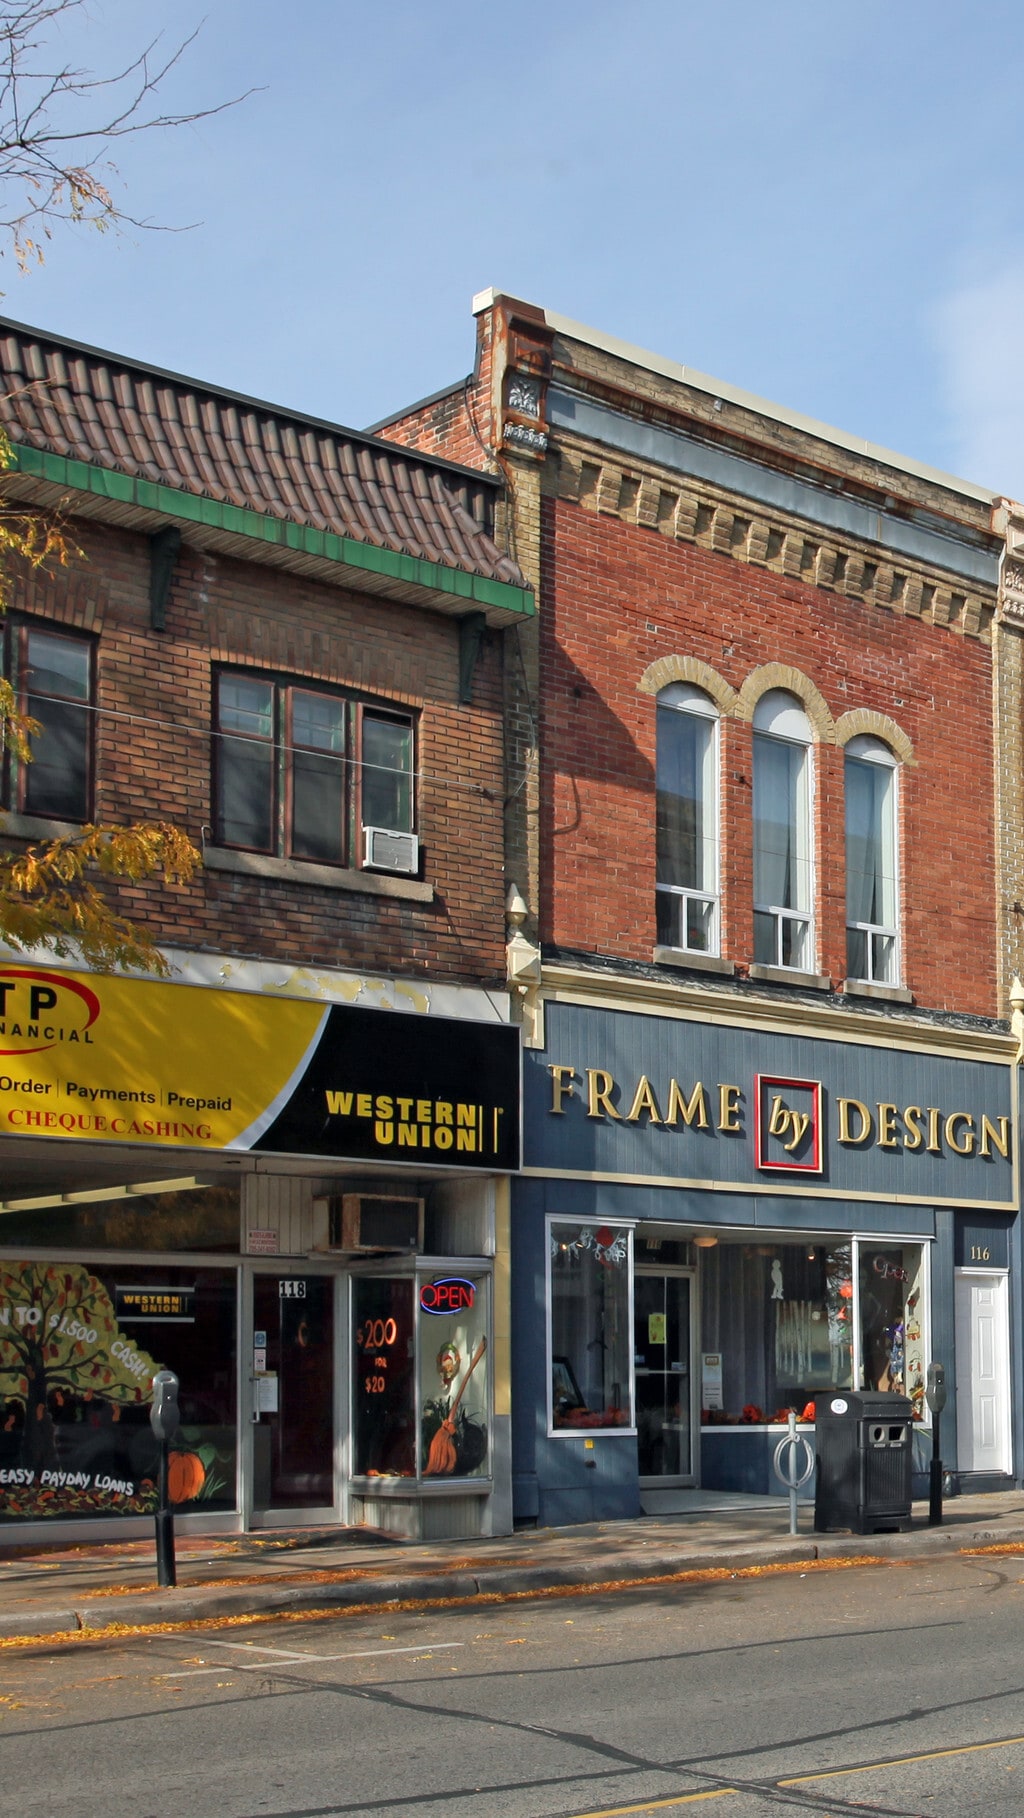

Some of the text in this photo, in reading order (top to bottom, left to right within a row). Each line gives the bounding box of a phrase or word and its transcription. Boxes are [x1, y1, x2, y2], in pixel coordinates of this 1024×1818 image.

[0, 1076, 232, 1111] Order Payments Prepaid
[325, 1090, 476, 1127] WESTERN
[547, 1064, 1010, 1157] FRAME by DESIGN
[7, 1108, 213, 1140] CHEQUE CASHING
[375, 1120, 476, 1152] UNION
[970, 1245, 990, 1261] 116
[124, 1295, 179, 1305] WESTERN
[280, 1281, 305, 1298] 118
[420, 1284, 474, 1308] OPEN
[141, 1304, 179, 1313] UNION
[16, 1306, 41, 1326] TO
[110, 1341, 150, 1381] CASH!
[365, 1376, 385, 1393] $20
[0, 1468, 134, 1496] EASY PAYDAY LOANS
